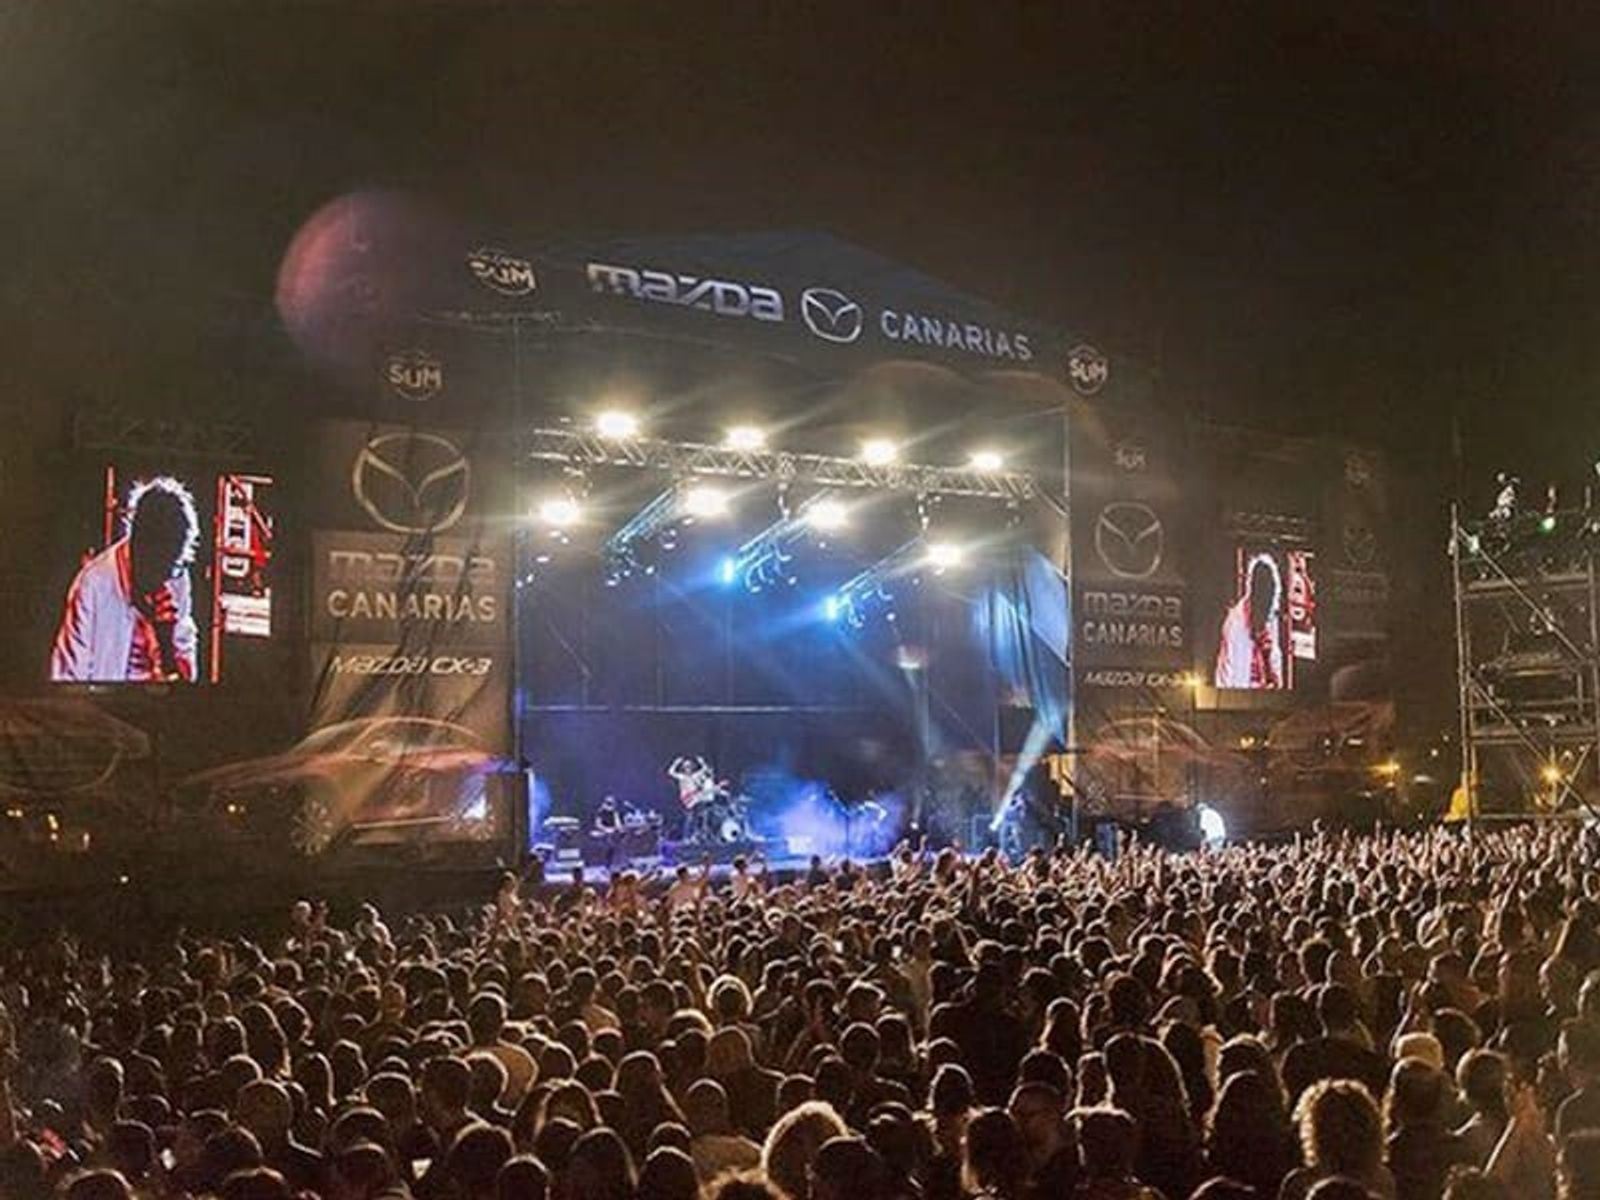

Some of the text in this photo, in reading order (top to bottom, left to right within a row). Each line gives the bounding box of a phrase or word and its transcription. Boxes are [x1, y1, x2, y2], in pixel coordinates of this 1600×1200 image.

[880, 309, 1033, 361] CANARIAS
[389, 362, 443, 389] SUM
[327, 588, 498, 623] CANARIAS
[1083, 621, 1184, 648] CANARIAS
[430, 656, 493, 676] CX-3
